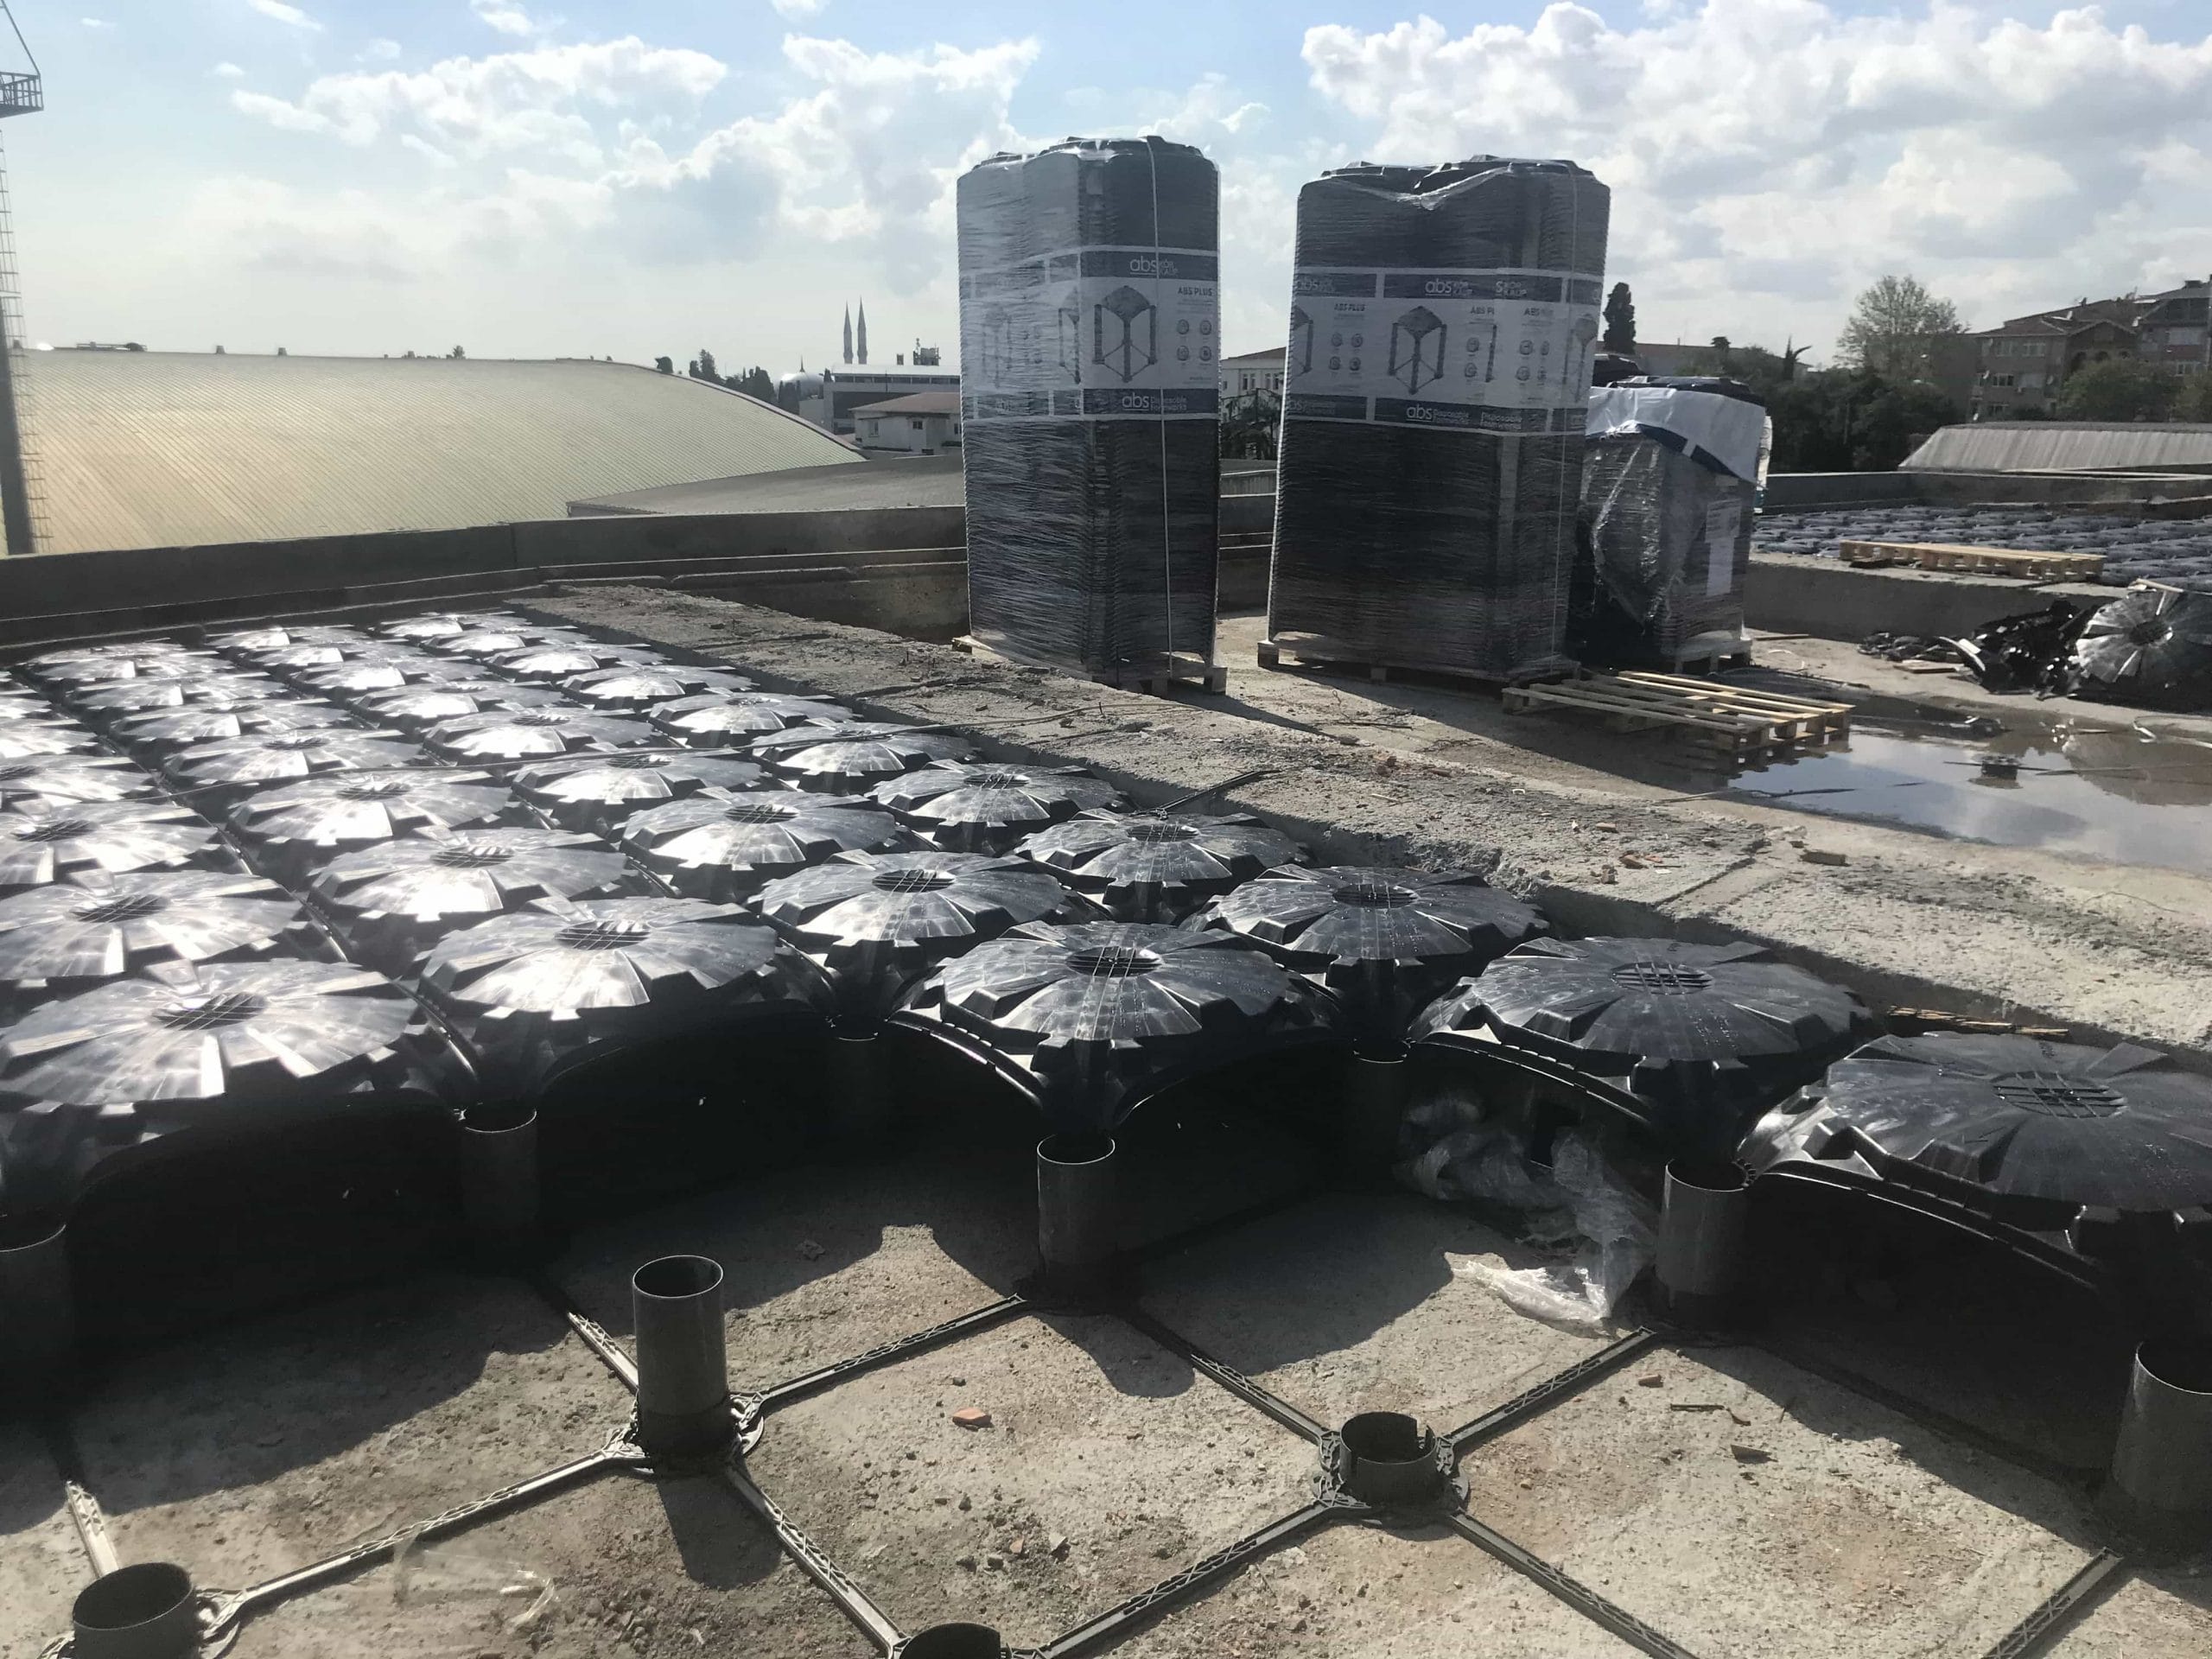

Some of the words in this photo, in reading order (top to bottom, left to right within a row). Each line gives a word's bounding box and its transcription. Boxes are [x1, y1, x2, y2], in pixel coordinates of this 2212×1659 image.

[1178, 286, 1192, 296] ABS
[1194, 287, 1212, 296] PLUS
[1425, 277, 1452, 294] abs
[1122, 391, 1150, 408] abs
[1406, 404, 1433, 420] abs
